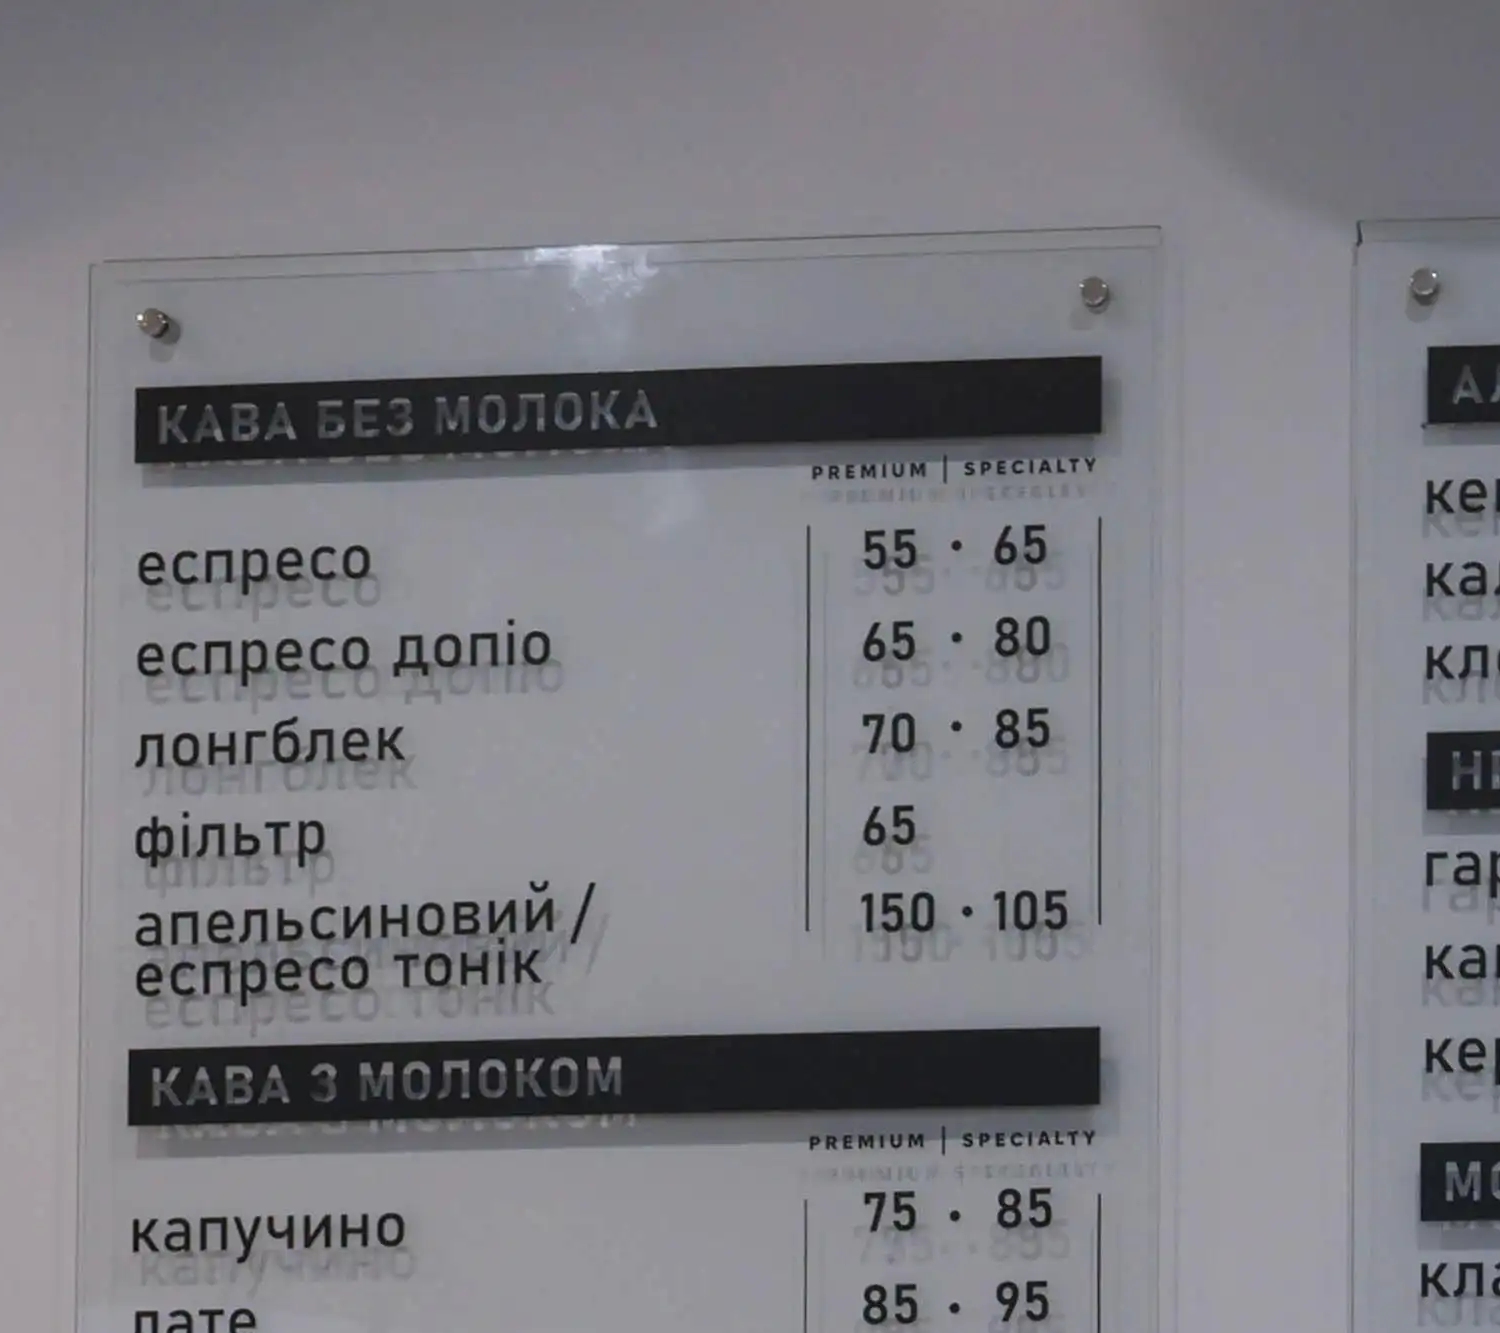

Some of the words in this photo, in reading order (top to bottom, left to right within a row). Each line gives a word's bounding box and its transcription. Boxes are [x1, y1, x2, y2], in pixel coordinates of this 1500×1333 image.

[156, 402, 298, 446] КАВА
[316, 398, 416, 439] БЕЗ
[434, 389, 659, 435] МОЛОКА
[810, 462, 929, 481] PREMIUM
[964, 457, 1098, 478] SPECIALTY
[138, 545, 370, 596] еспресо
[864, 528, 917, 570] 55
[994, 524, 1046, 566] 65
[137, 636, 370, 687] еспресо
[393, 619, 550, 678] допіо
[135, 716, 405, 768] лонгблек
[862, 712, 915, 754] 70
[995, 707, 1050, 749] 85
[135, 811, 325, 868] фільтр
[861, 892, 935, 933] 150
[994, 890, 1068, 932] 105
[136, 955, 369, 1007] еспресо
[393, 931, 542, 988] тонік
[149, 1066, 292, 1108] КАВА
[310, 1062, 339, 1104] З
[359, 1057, 624, 1102] МОЛОКОМ
[808, 1133, 926, 1152] PREMIUM
[961, 1129, 1097, 1149] SPECIALTY
[132, 1213, 405, 1264] капучино
[863, 1283, 918, 1325] 85
[996, 1280, 1049, 1322] 95
